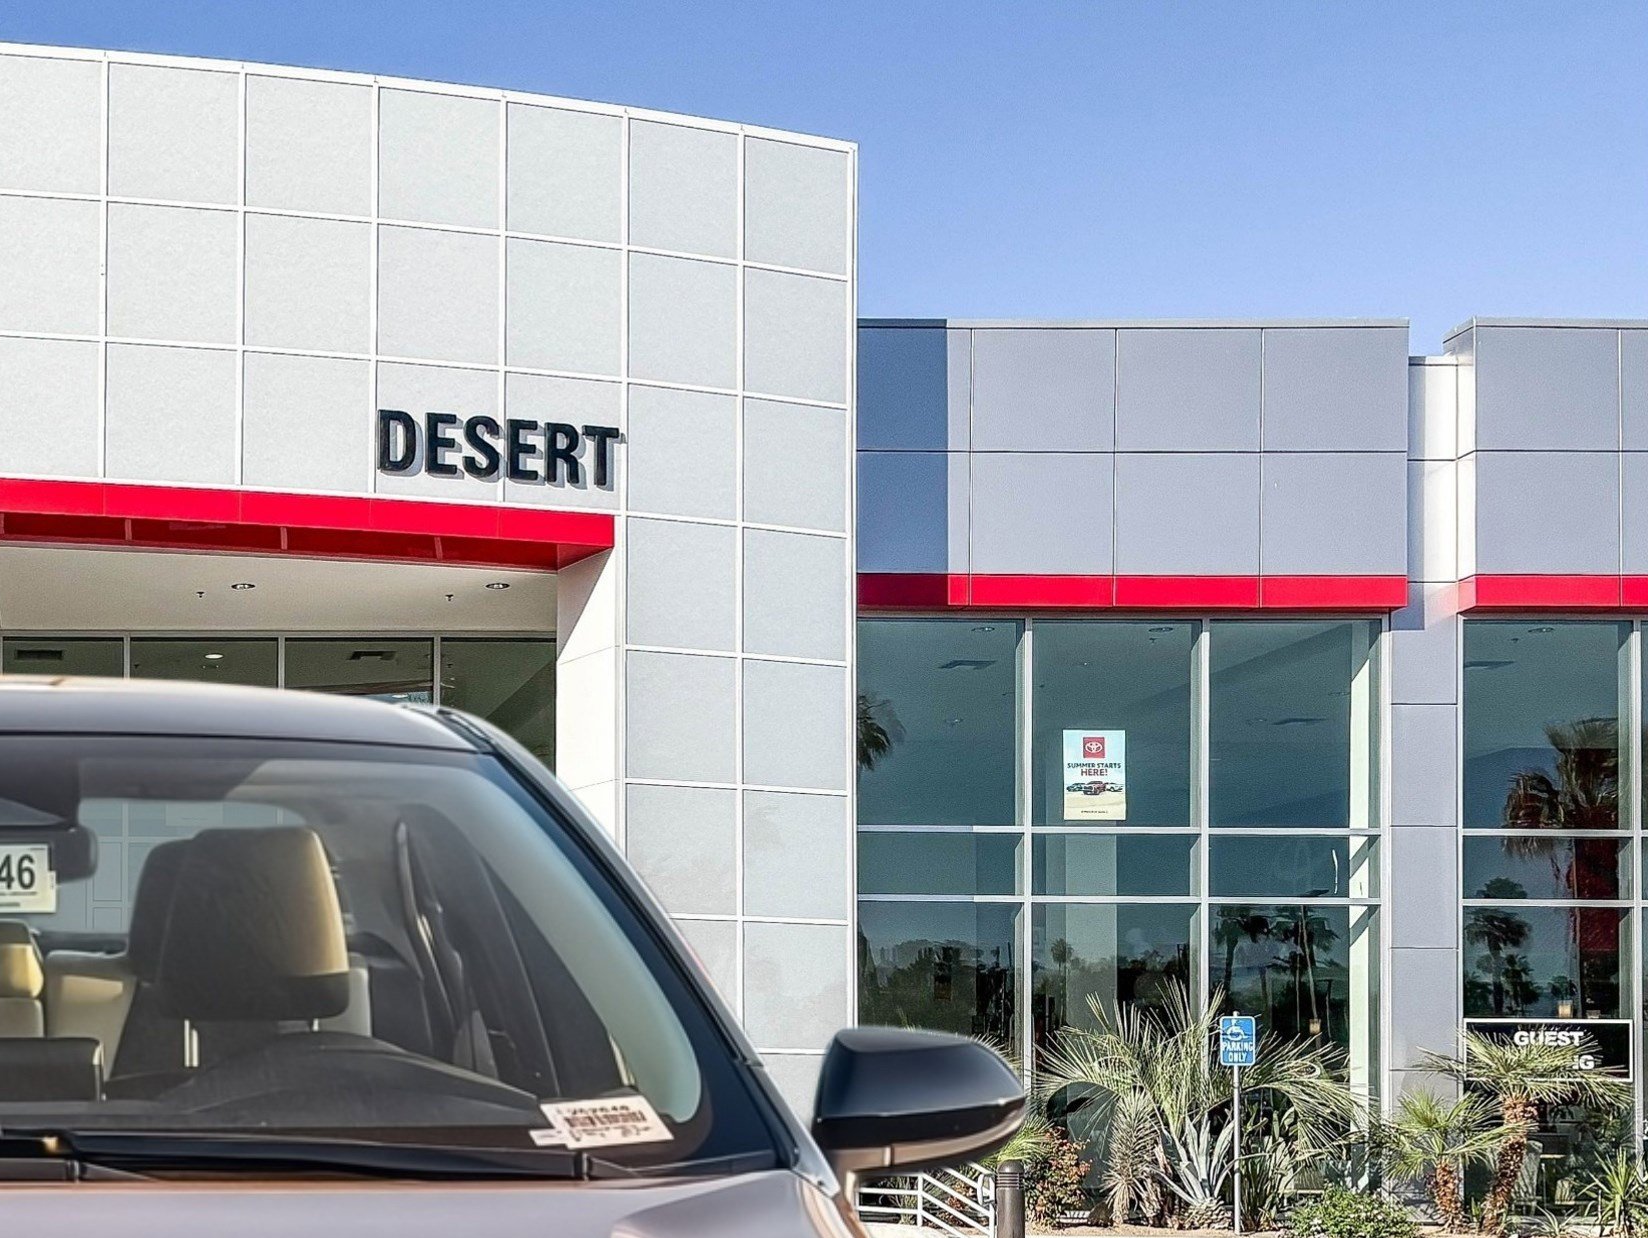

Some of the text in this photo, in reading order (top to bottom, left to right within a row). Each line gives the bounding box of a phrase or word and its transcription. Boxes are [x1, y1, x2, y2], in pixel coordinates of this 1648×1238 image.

[377, 409, 621, 487] DESERT
[1513, 1030, 1584, 1047] GUEST
[1222, 1041, 1253, 1052] PARKING
[1228, 1051, 1248, 1063] ONLY
